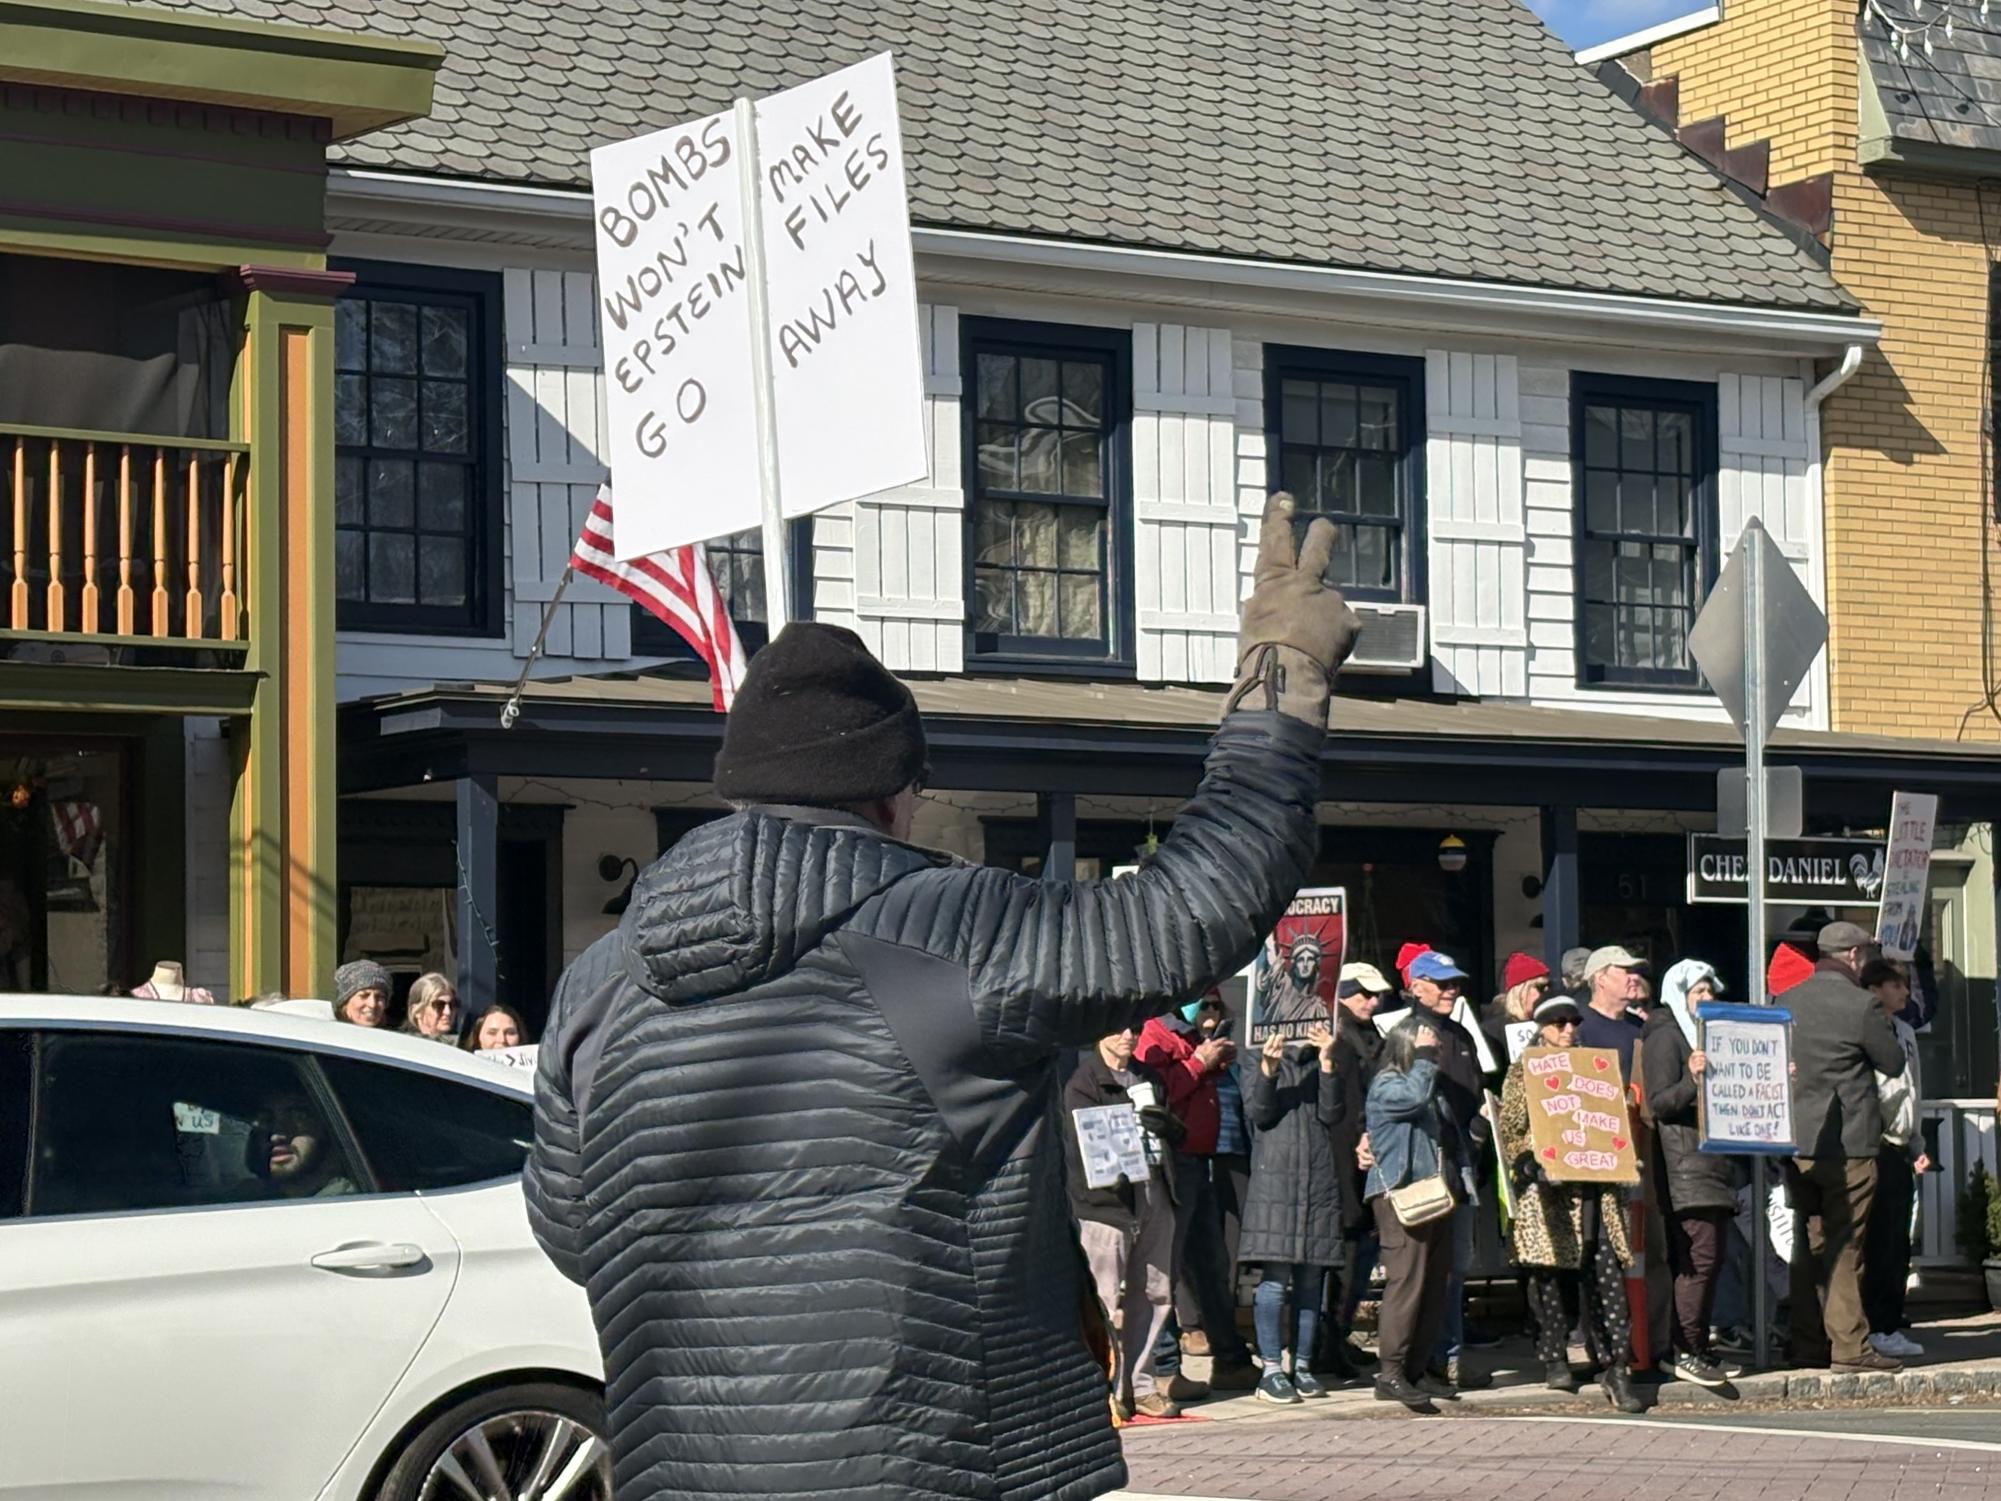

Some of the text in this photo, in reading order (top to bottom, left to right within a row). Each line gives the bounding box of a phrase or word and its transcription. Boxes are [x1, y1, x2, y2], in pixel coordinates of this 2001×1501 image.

[600, 117, 731, 248] BOMBS
[604, 90, 863, 330] WON'T MAKE
[614, 133, 888, 393] EPSTEIN FILES
[636, 238, 886, 458] GO AWAY
[1768, 856, 1846, 885] DANIEL
[1285, 898, 1340, 916] OCRACY
[1712, 1036, 1722, 1052] IF
[1729, 1039, 1750, 1055] YOU
[1531, 1055, 1569, 1072] HATE
[1713, 1062, 1772, 1080] WANT TO BE
[1575, 1077, 1615, 1098] DOES
[1712, 1084, 1746, 1099] CALLED
[1748, 1087, 1754, 1097] A
[1546, 1096, 1576, 1111] NOT
[1712, 1103, 1738, 1116] THEN
[1767, 1103, 1786, 1119] ACT
[1577, 1112, 1617, 1130] MAKE
[1728, 1121, 1780, 1137] LIKE ONE!
[1564, 1131, 1584, 1144] US
[1567, 1153, 1616, 1167] GREAT
